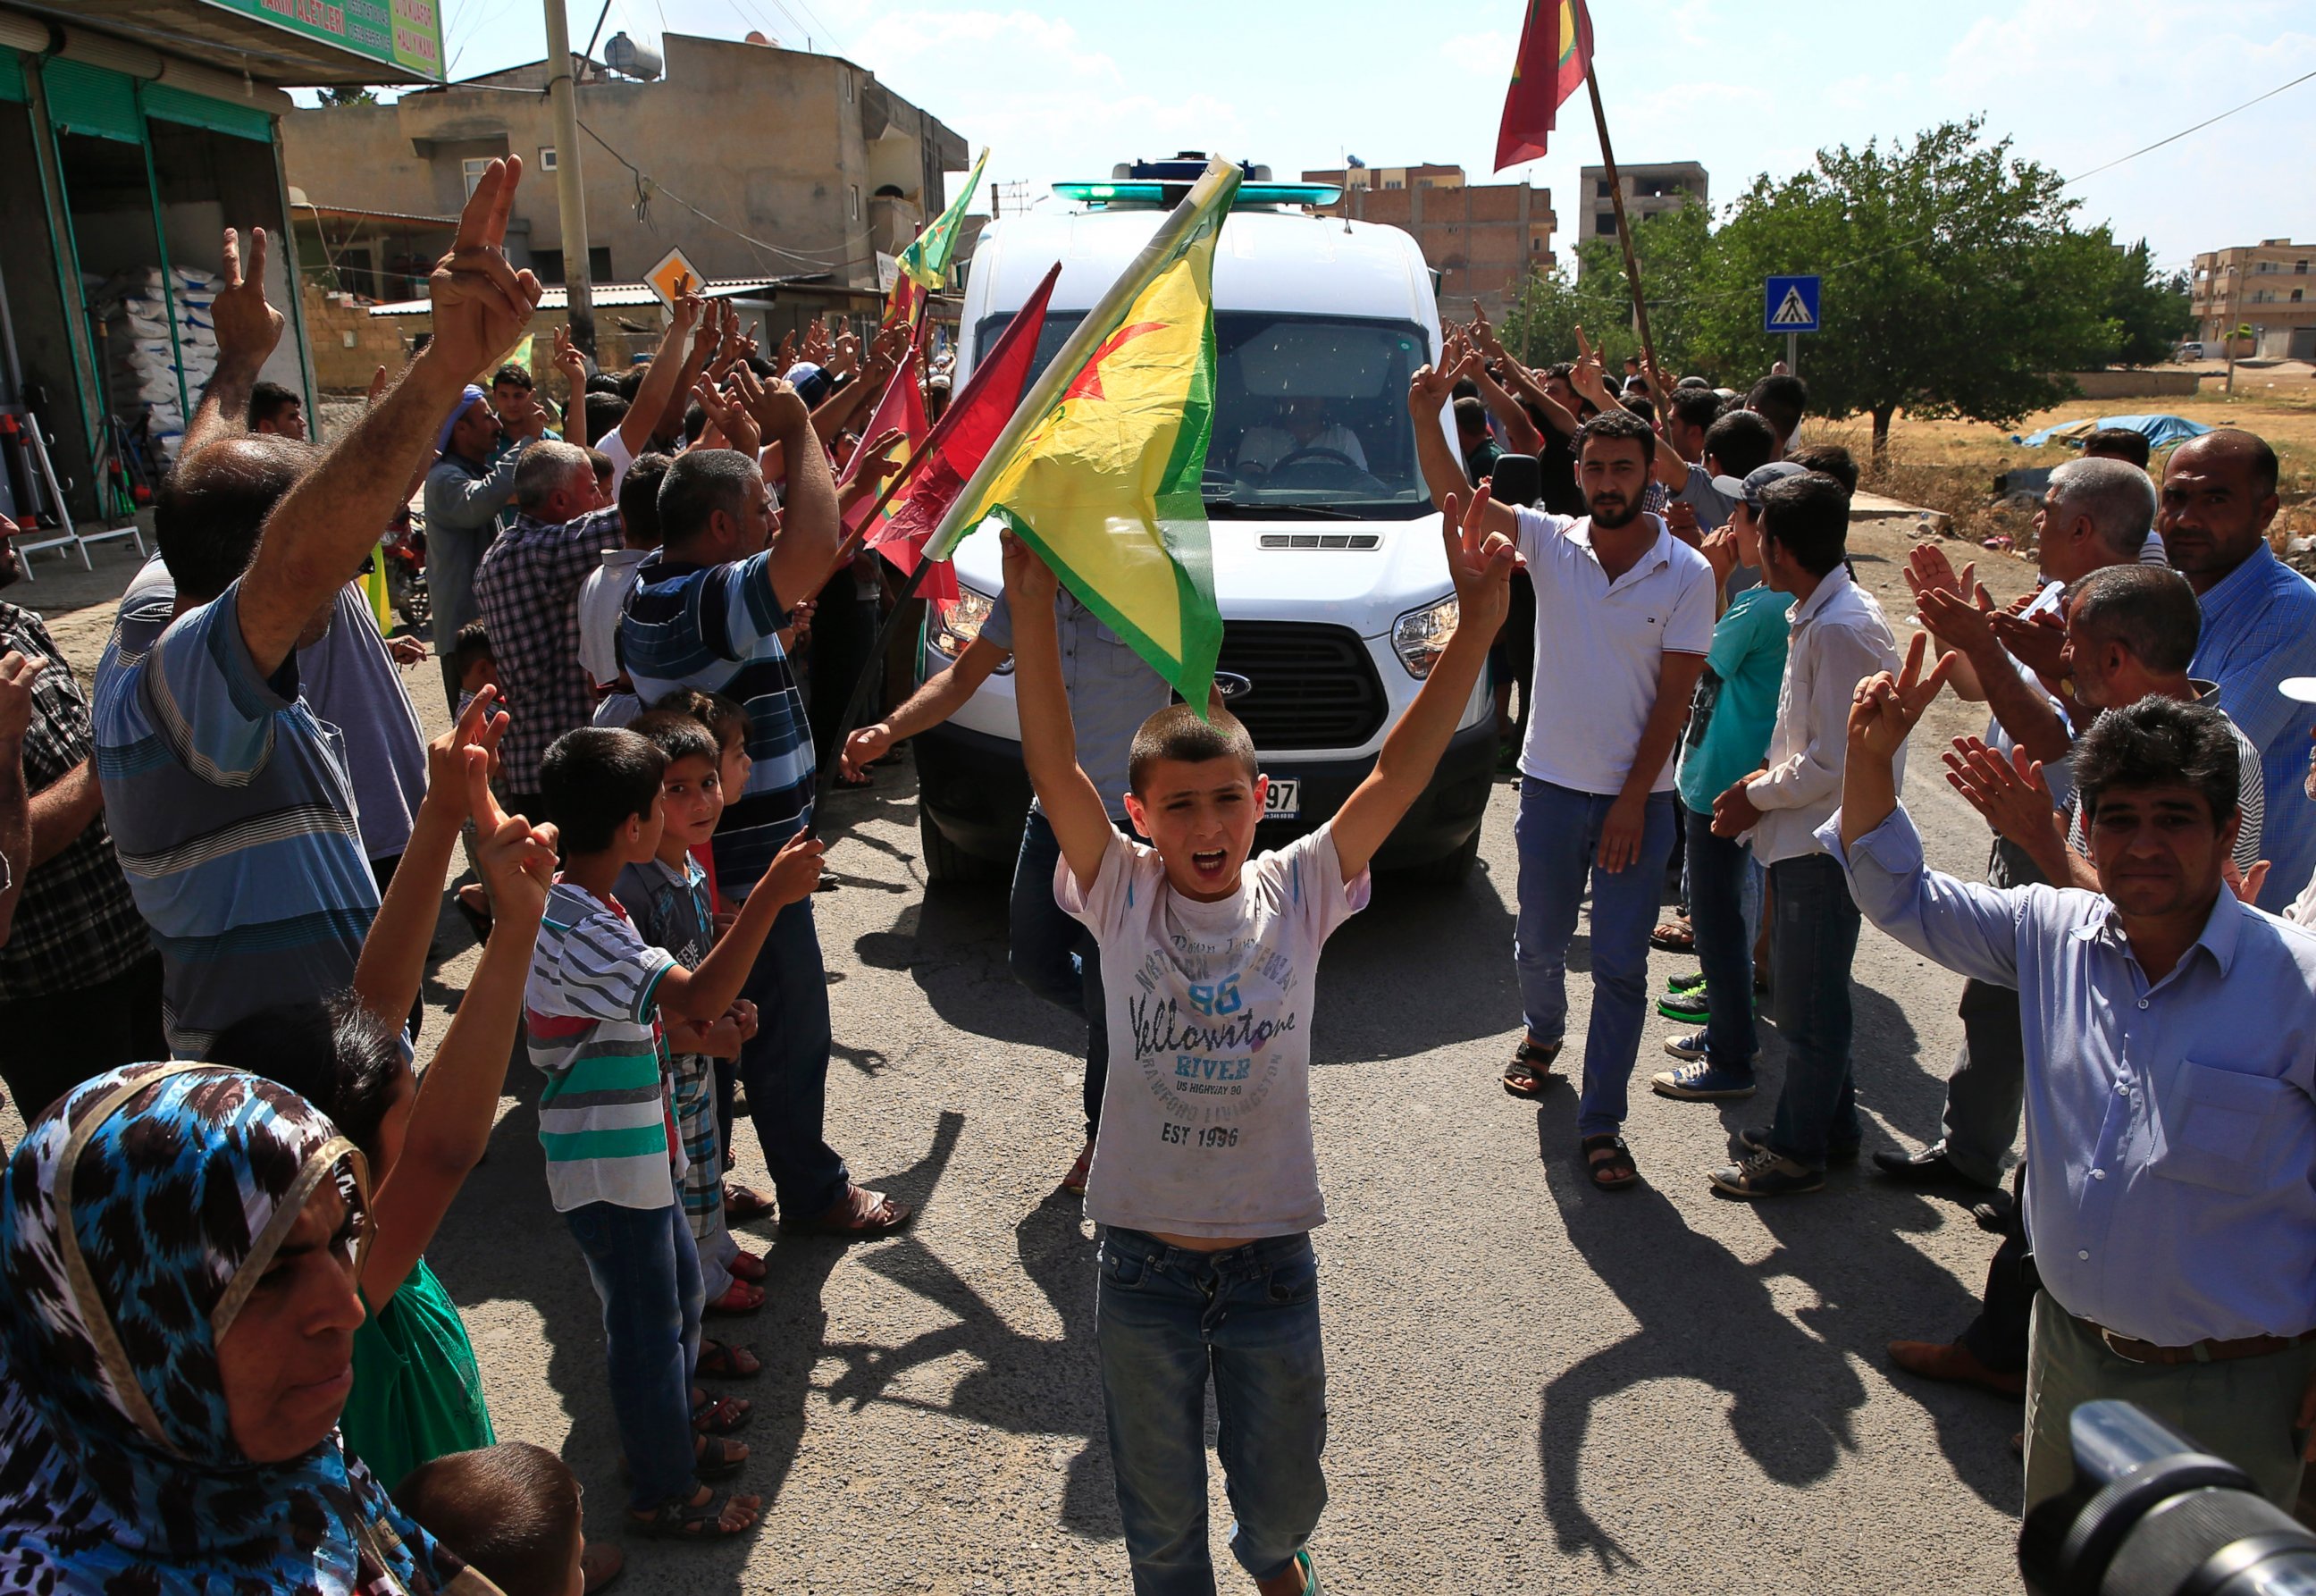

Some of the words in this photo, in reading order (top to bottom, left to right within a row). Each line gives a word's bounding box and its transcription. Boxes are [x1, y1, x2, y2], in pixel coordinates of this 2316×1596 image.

[1187, 972, 1242, 1016] 96
[1129, 992, 1296, 1061] Yellowstone
[1175, 1054, 1251, 1080] RIVER
[1176, 1079, 1187, 1092] US
[1189, 1083, 1228, 1096] HIGHWAY
[1162, 1121, 1191, 1147] EST
